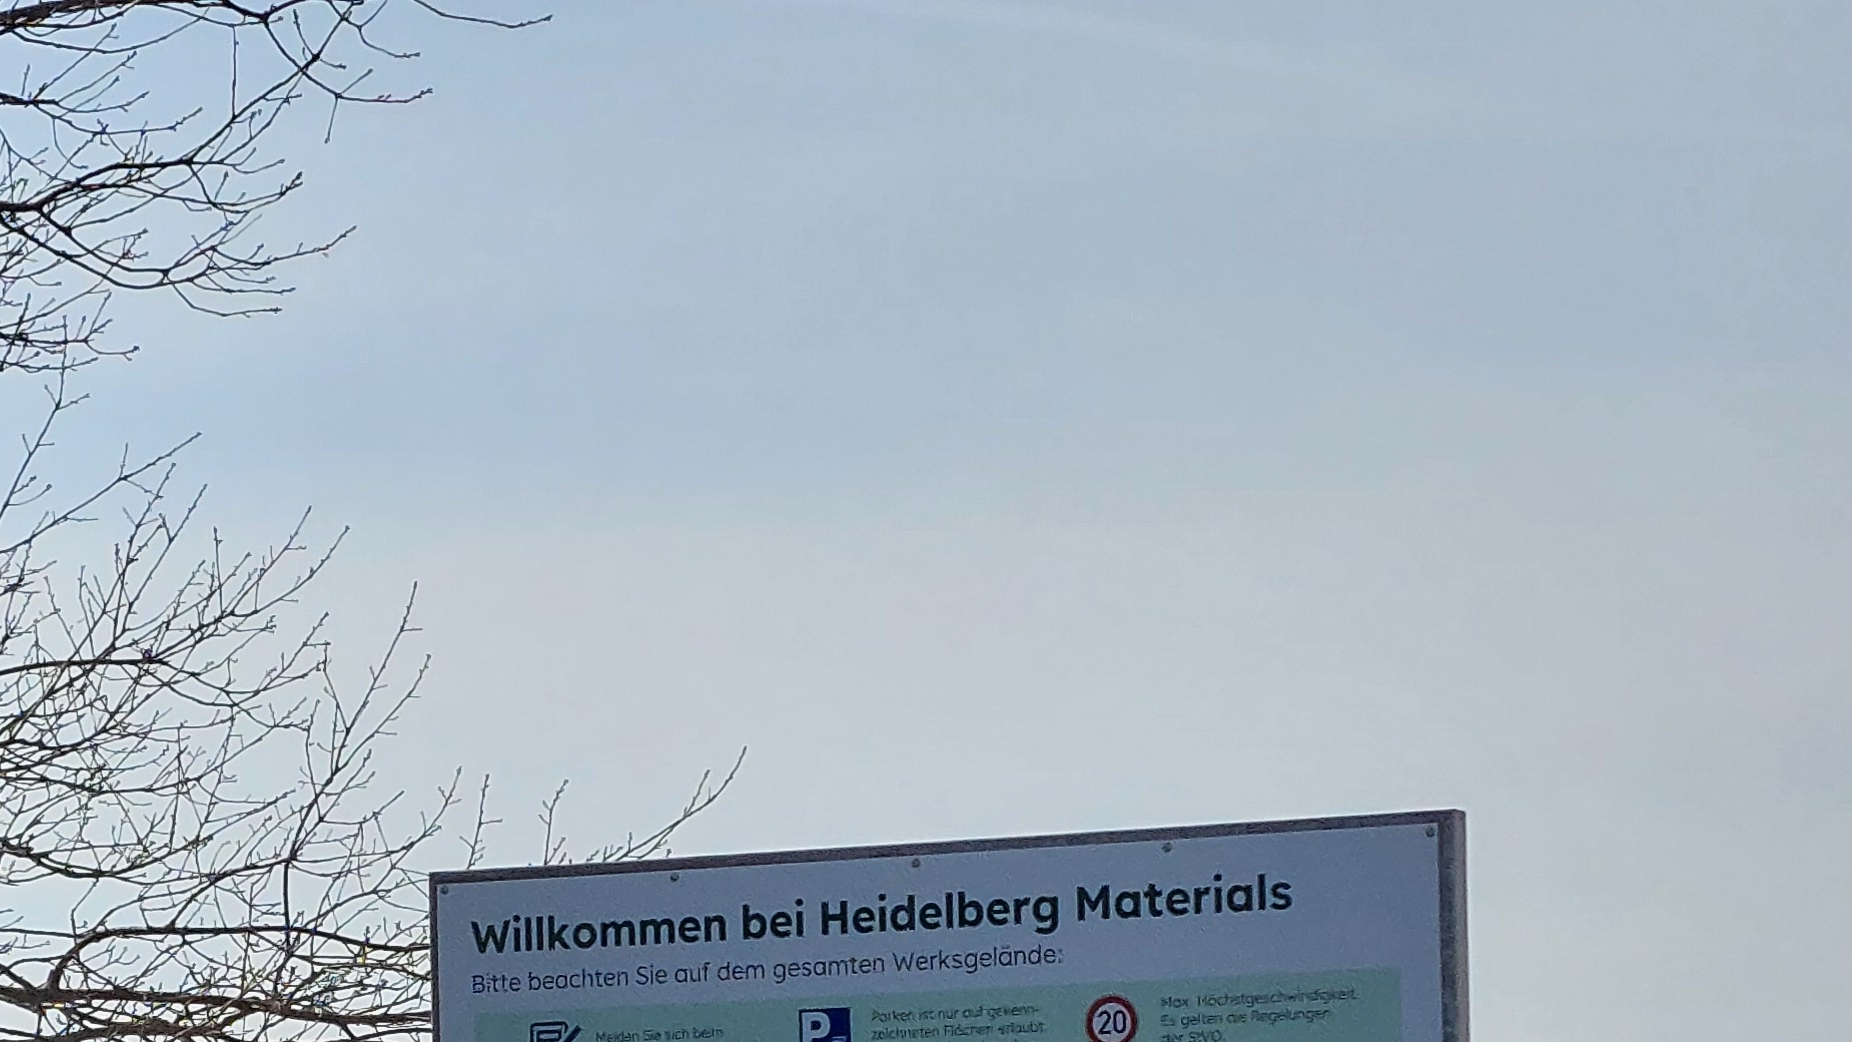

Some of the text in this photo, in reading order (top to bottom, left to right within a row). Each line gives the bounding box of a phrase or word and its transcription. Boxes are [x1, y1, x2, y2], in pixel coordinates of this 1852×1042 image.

[471, 873, 1292, 954] Willkommen bei Heidelberg Materials
[472, 944, 1064, 993] Bitte beachten Sie auf dem gesamten Werksgelände:
[643, 1029, 661, 1042] Sie
[1098, 1010, 1127, 1035] 20
